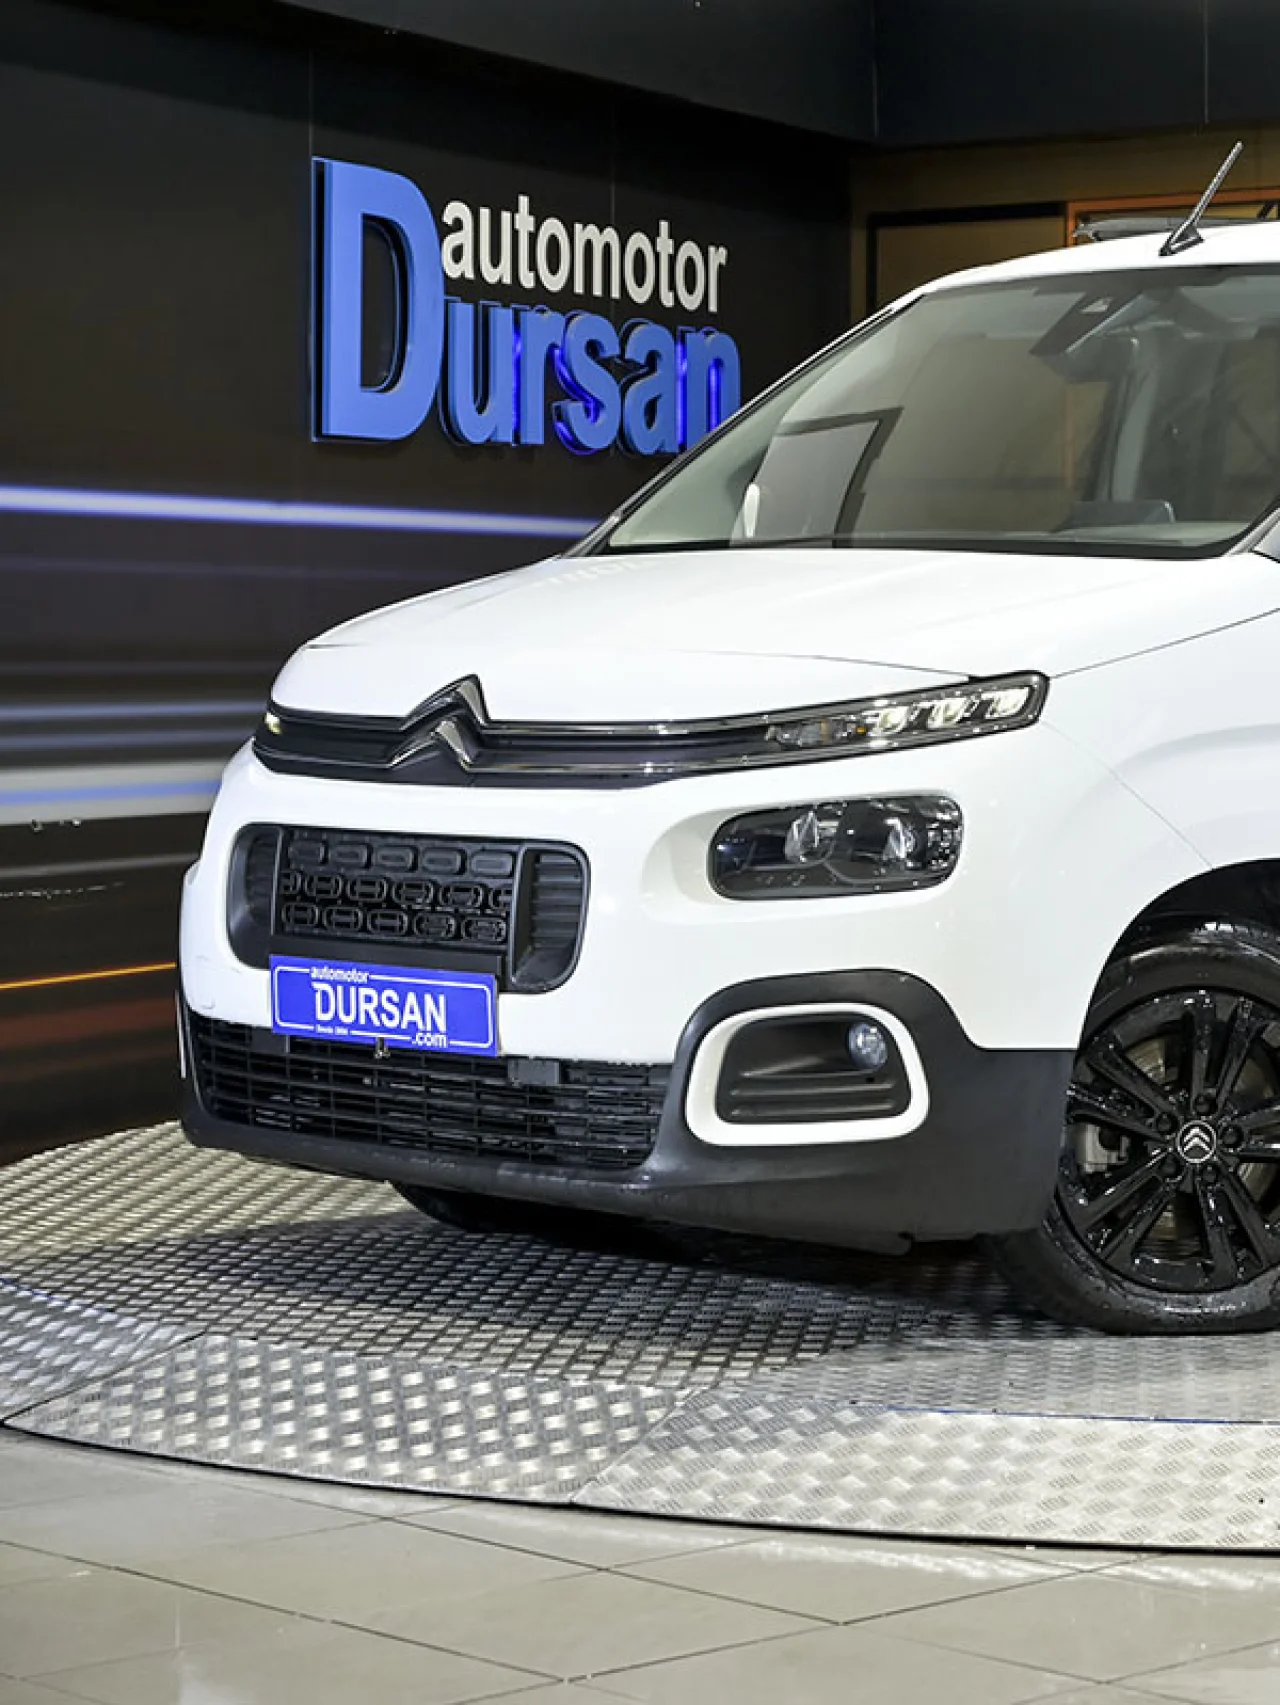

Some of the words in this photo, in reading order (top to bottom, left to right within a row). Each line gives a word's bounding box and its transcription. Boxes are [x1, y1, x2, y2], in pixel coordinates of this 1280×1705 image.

[441, 193, 727, 313] automotor
[311, 156, 742, 457] Dursan
[309, 965, 370, 984] automotor
[311, 981, 448, 1032] DURSAN
[411, 1031, 448, 1049] .com
